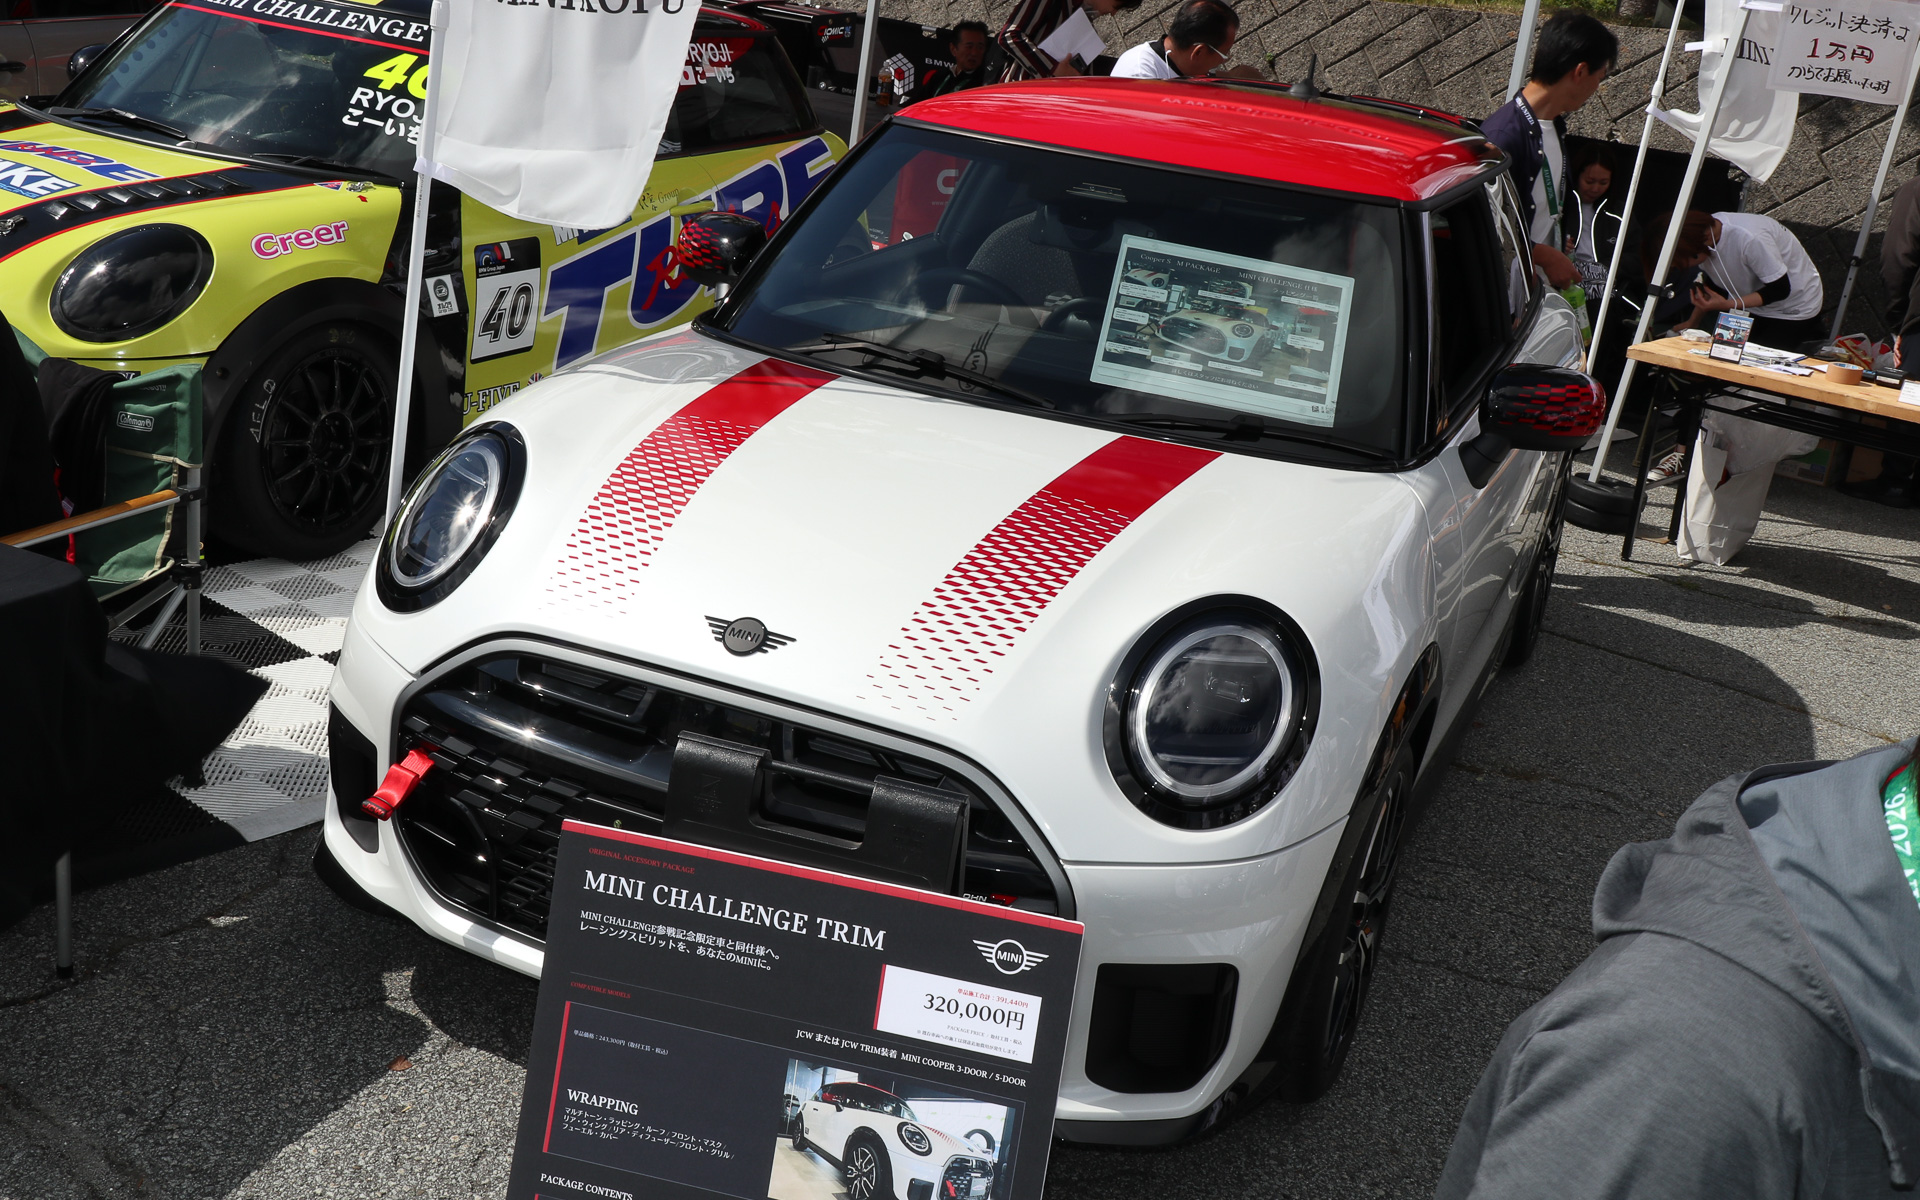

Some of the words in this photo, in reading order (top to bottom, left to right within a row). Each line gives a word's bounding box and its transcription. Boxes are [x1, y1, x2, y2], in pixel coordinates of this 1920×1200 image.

[1807, 38, 1875, 64] 1万円
[251, 220, 349, 260] Creer
[1184, 262, 1222, 274] PACKAGE
[1256, 275, 1303, 290] CHALLENGE
[478, 282, 534, 343] 40
[728, 628, 760, 644] MINI
[588, 847, 622, 860] ORIGINAL
[622, 854, 662, 868] ACCESSORY
[662, 862, 695, 874] PACKAGE
[580, 910, 602, 922] MINI
[583, 870, 646, 902] MINI
[652, 884, 809, 935] CHALLENGE
[816, 917, 886, 951] TRIM
[579, 921, 773, 972] レーシングスピリットを、あなたのMINIに。
[996, 950, 1023, 964] MINI
[570, 981, 607, 995] COMPATIBLE
[607, 988, 632, 999] MODELS
[922, 993, 1026, 1031] 320,000円
[795, 1029, 815, 1042] JCW
[815, 1032, 840, 1047] または
[840, 1038, 859, 1050] JCW
[860, 1043, 898, 1060] TRIM装着
[900, 1052, 922, 1064] MINI
[922, 1057, 956, 1073] COOPER
[956, 1064, 988, 1080] 3-DOOR
[995, 1072, 1027, 1088] 5-DOOR
[567, 1088, 639, 1116] WRAPPING
[562, 1122, 619, 1142] フューエル・カバー
[540, 1173, 584, 1192] PACKAGE
[585, 1183, 633, 1200] CONTENTS
